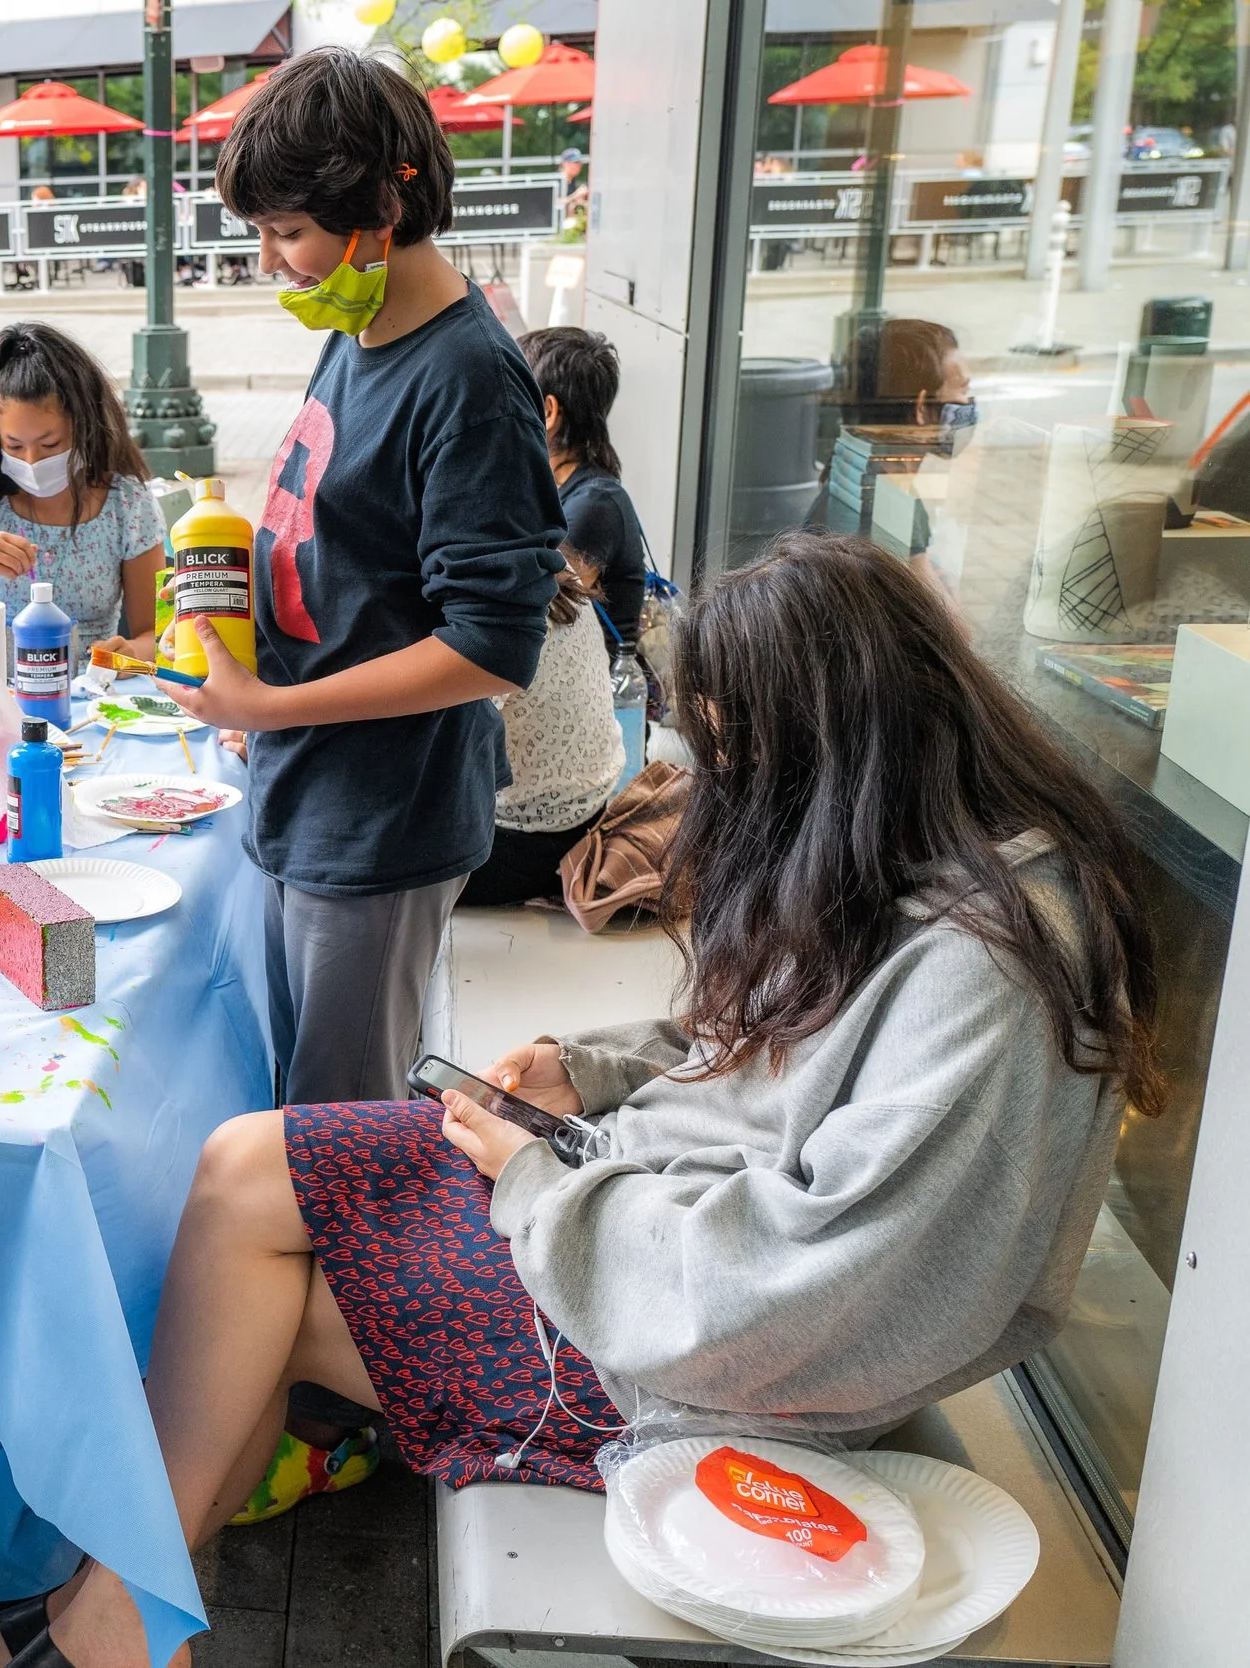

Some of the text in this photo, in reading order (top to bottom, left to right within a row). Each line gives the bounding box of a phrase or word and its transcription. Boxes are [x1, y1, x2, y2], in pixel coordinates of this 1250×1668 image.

[453, 203, 519, 217] EAKHOUSE
[186, 553, 228, 566] BLICK
[186, 572, 229, 581] PREMIUM
[27, 653, 58, 662] BLICK
[736, 1482, 807, 1513] corner
[784, 1528, 812, 1543] 100
